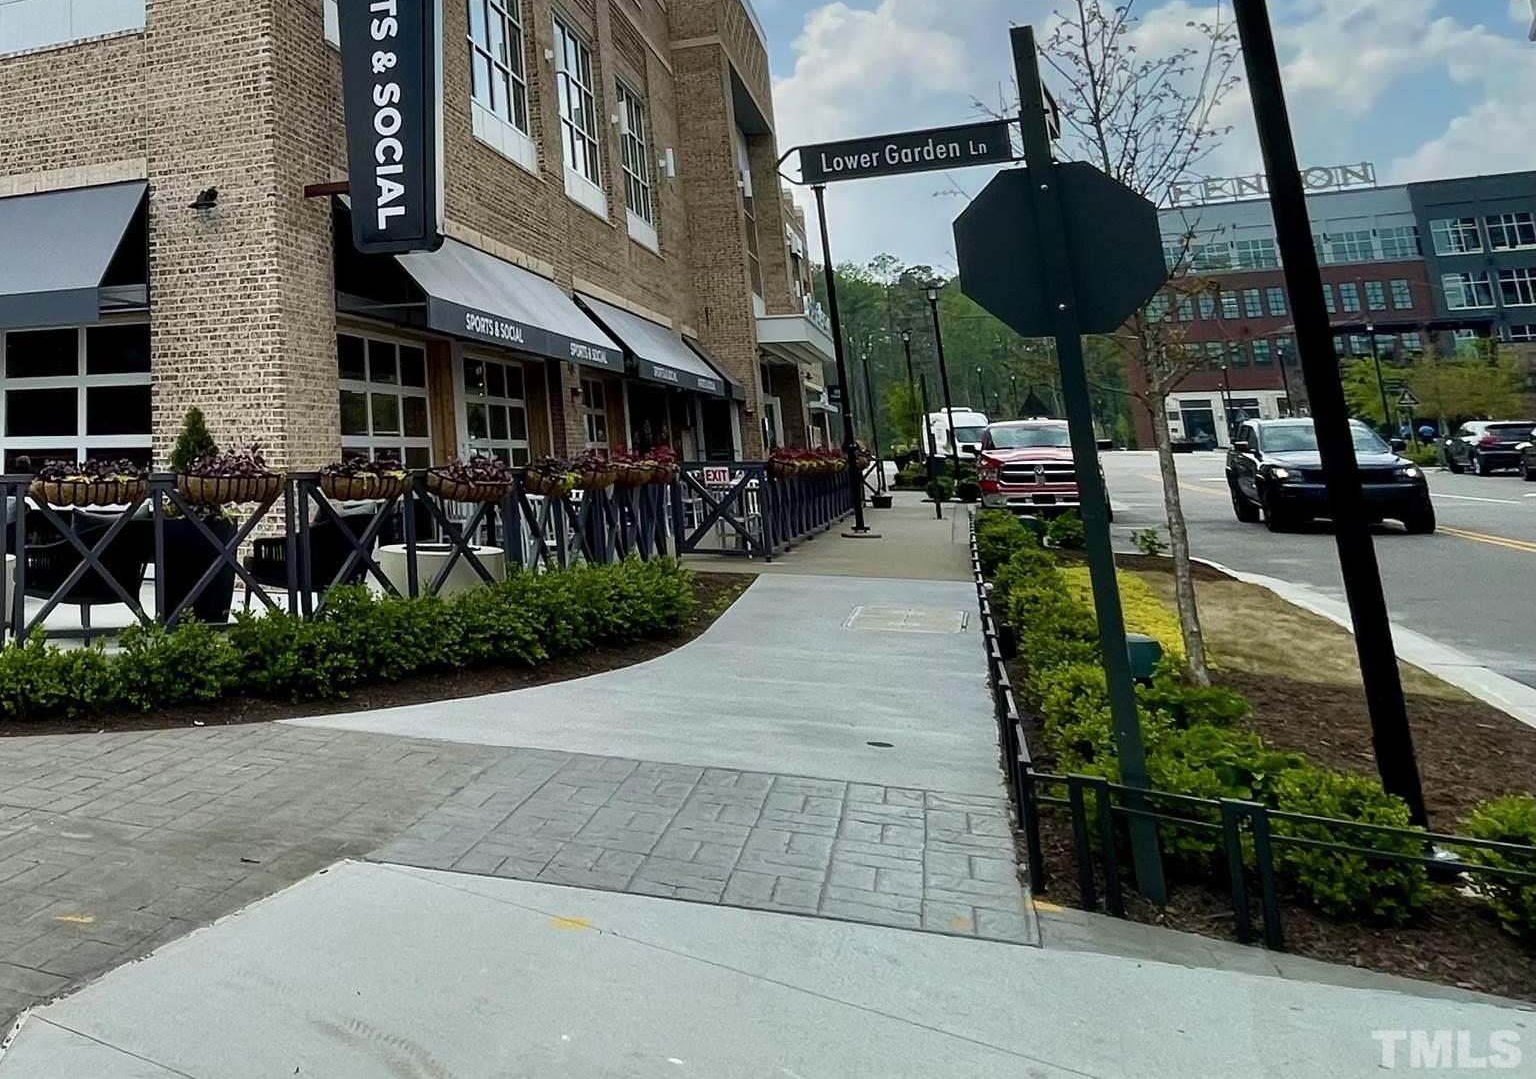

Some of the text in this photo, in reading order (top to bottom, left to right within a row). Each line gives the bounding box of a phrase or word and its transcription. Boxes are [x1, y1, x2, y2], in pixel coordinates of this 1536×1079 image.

[371, 51, 397, 74] &
[373, 82, 405, 230] SOCIAL
[820, 138, 988, 173] Lower Garden Ln
[1167, 161, 1375, 204] FENON
[465, 312, 525, 344] SPORTS & SOCIAL
[706, 469, 727, 481] EXIT
